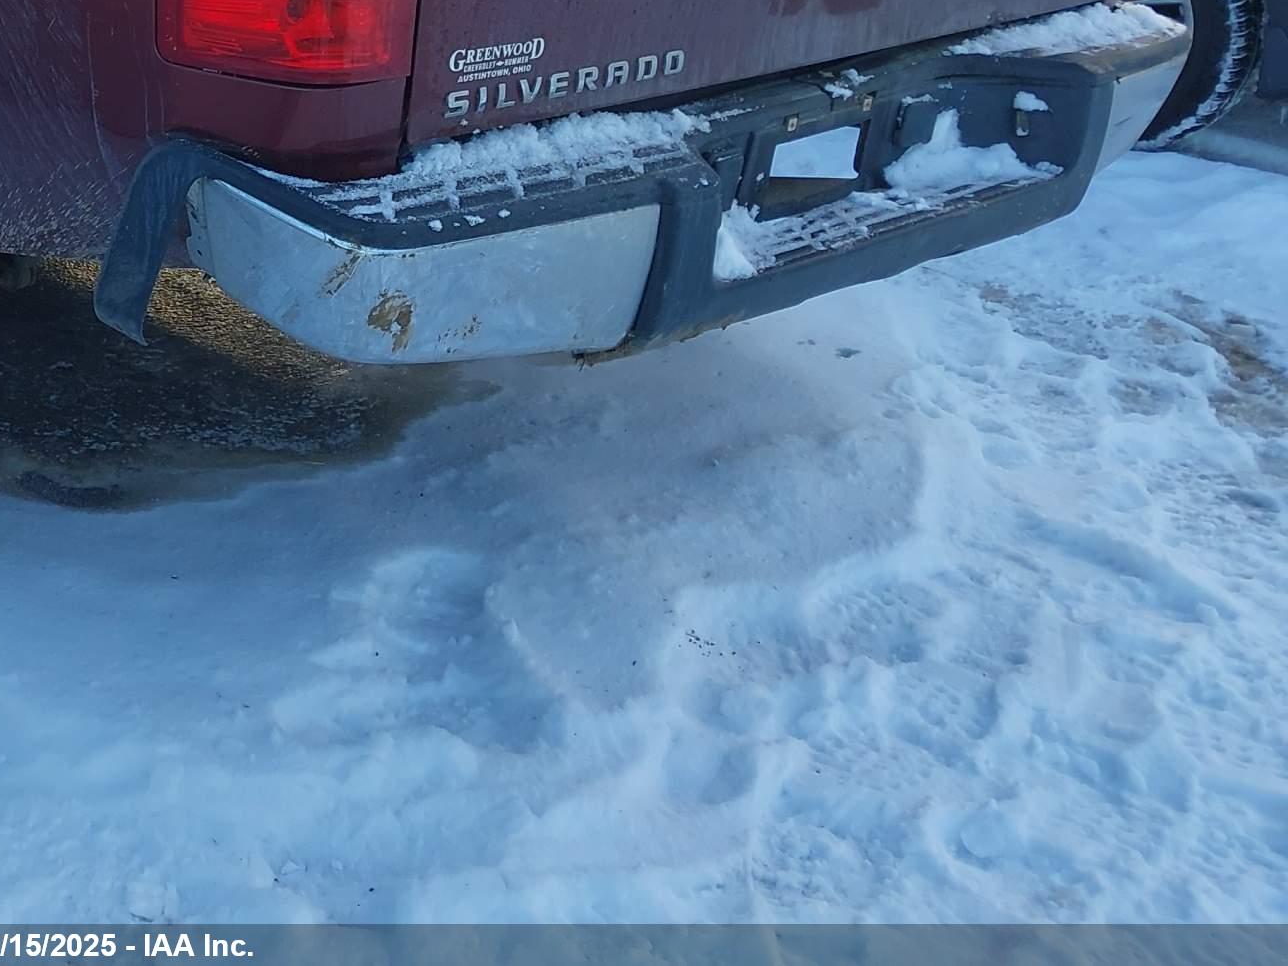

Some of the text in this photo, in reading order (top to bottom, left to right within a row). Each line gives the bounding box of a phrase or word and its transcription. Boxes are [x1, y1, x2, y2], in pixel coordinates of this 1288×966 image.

[449, 37, 545, 72] GREENWOOD
[463, 60, 497, 73] CHEVROLET
[444, 49, 686, 118] SILVERADO
[457, 64, 532, 84] AUSTINTOWN, OHIO
